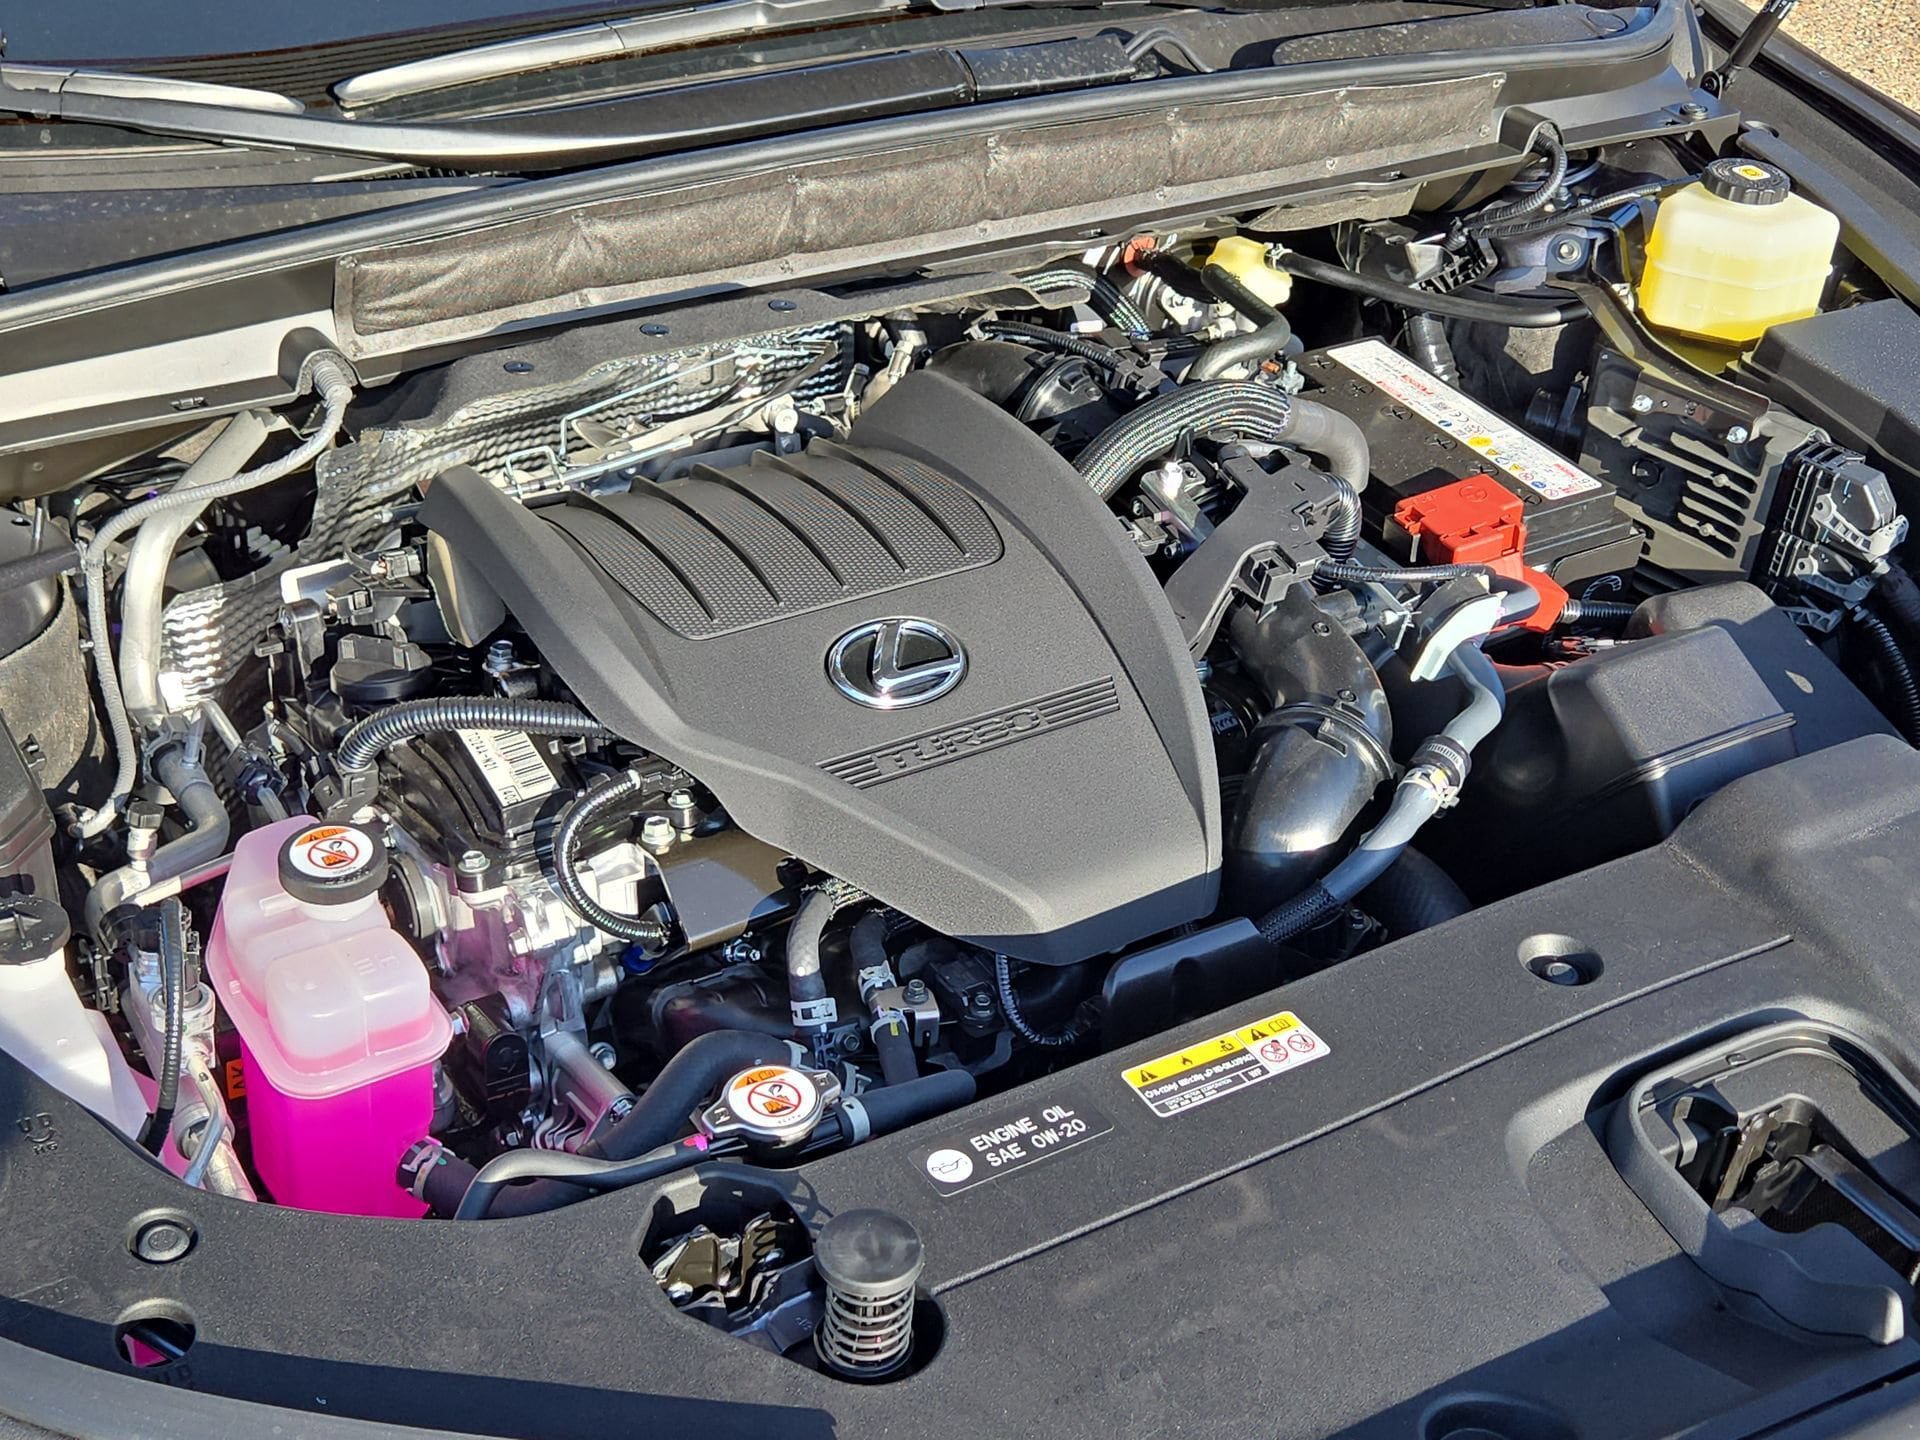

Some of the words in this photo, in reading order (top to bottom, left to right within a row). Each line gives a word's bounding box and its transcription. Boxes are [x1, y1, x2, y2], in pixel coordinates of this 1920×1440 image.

[875, 708, 1042, 770] TURBO
[970, 1117, 1038, 1152] ENGINE
[1042, 1105, 1075, 1123] OIL
[986, 1143, 1027, 1167] SAE
[1031, 1118, 1087, 1148] 0W-20
